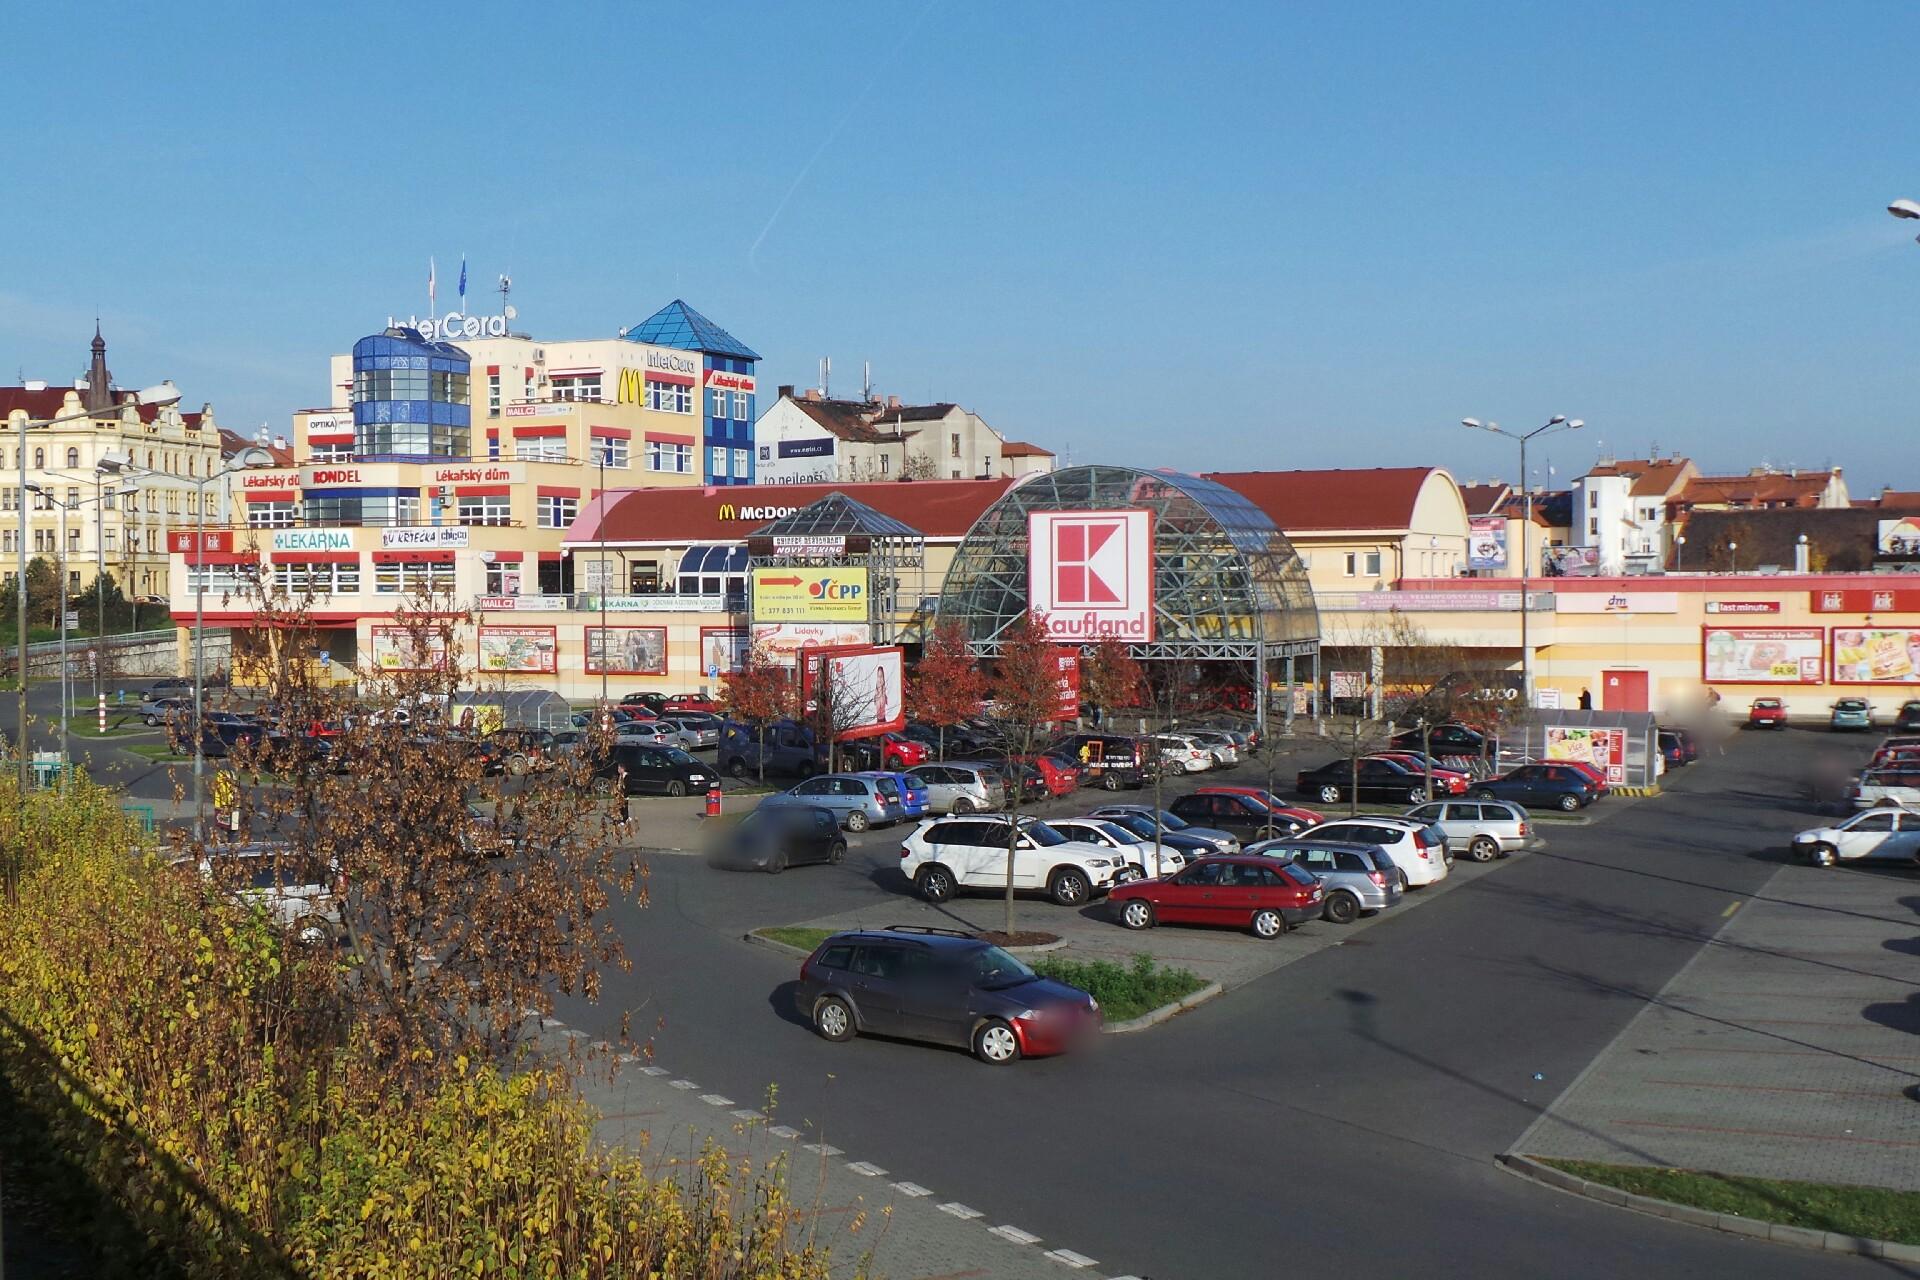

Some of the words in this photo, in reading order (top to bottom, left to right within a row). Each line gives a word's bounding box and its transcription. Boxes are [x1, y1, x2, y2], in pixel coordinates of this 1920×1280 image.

[507, 406, 535, 416] MALL.CZ
[310, 421, 335, 429] OPTIKA
[243, 474, 285, 488] Lékařský
[287, 473, 300, 486] dů
[313, 470, 361, 484] RONDEL
[435, 469, 482, 483] Lékařský
[485, 469, 509, 481] dům
[178, 534, 191, 550] kik
[206, 534, 219, 550] kik
[828, 580, 861, 599] ČPP
[482, 599, 513, 608] MALL.CZ
[1607, 595, 1627, 606] dm
[1824, 593, 1841, 609] kik
[1875, 593, 1892, 609] kik
[795, 627, 824, 635] Lidovky
